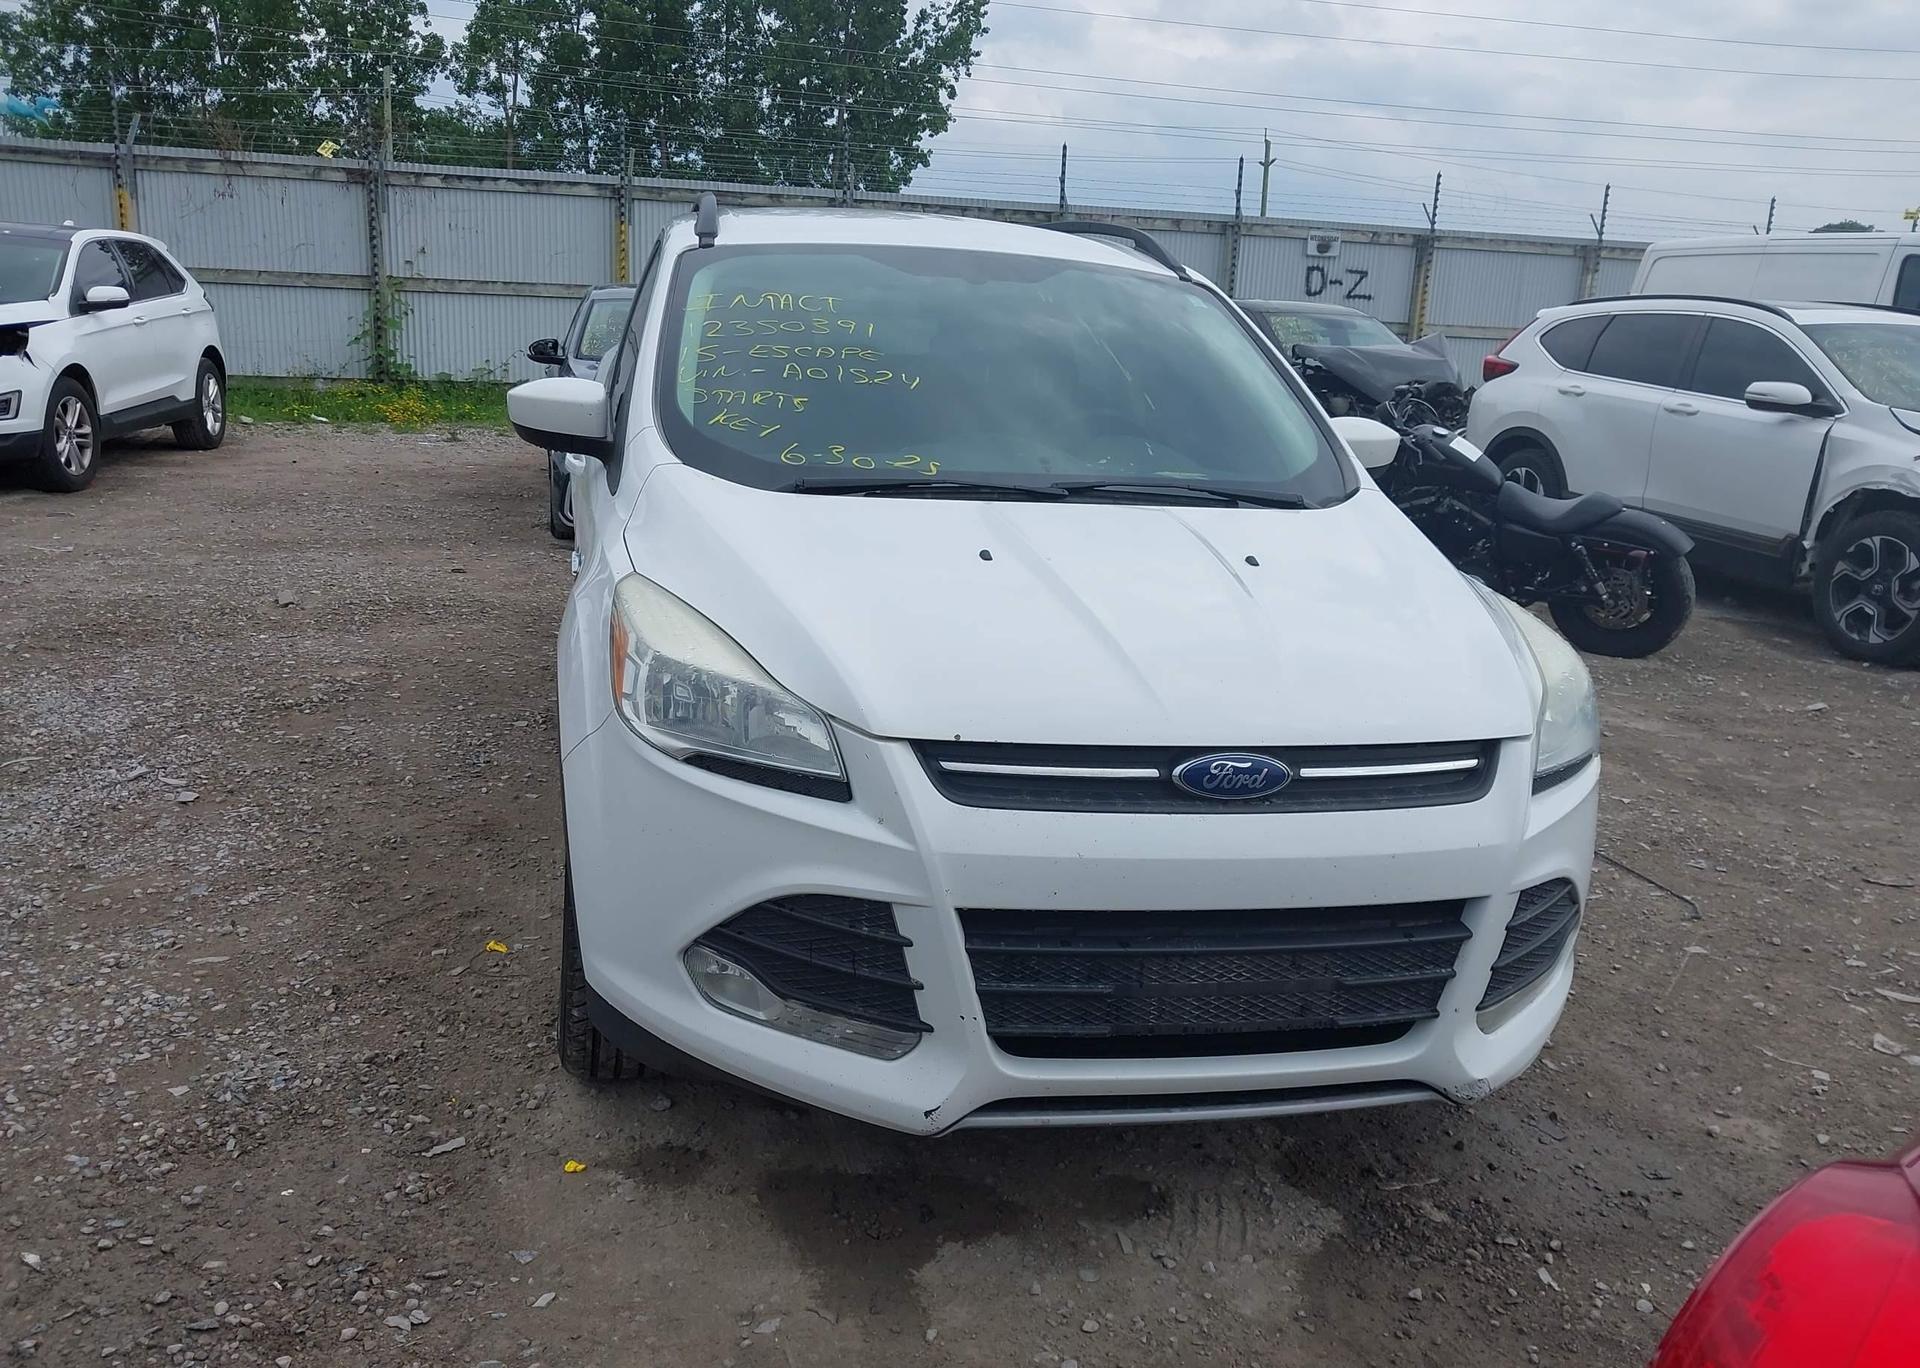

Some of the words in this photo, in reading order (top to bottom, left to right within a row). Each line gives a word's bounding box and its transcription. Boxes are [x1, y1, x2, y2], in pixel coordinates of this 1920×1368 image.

[1305, 264, 1373, 301] D-Z
[682, 292, 842, 312] INTACT
[708, 408, 781, 437] KEY
[1203, 761, 1269, 789] Ford
